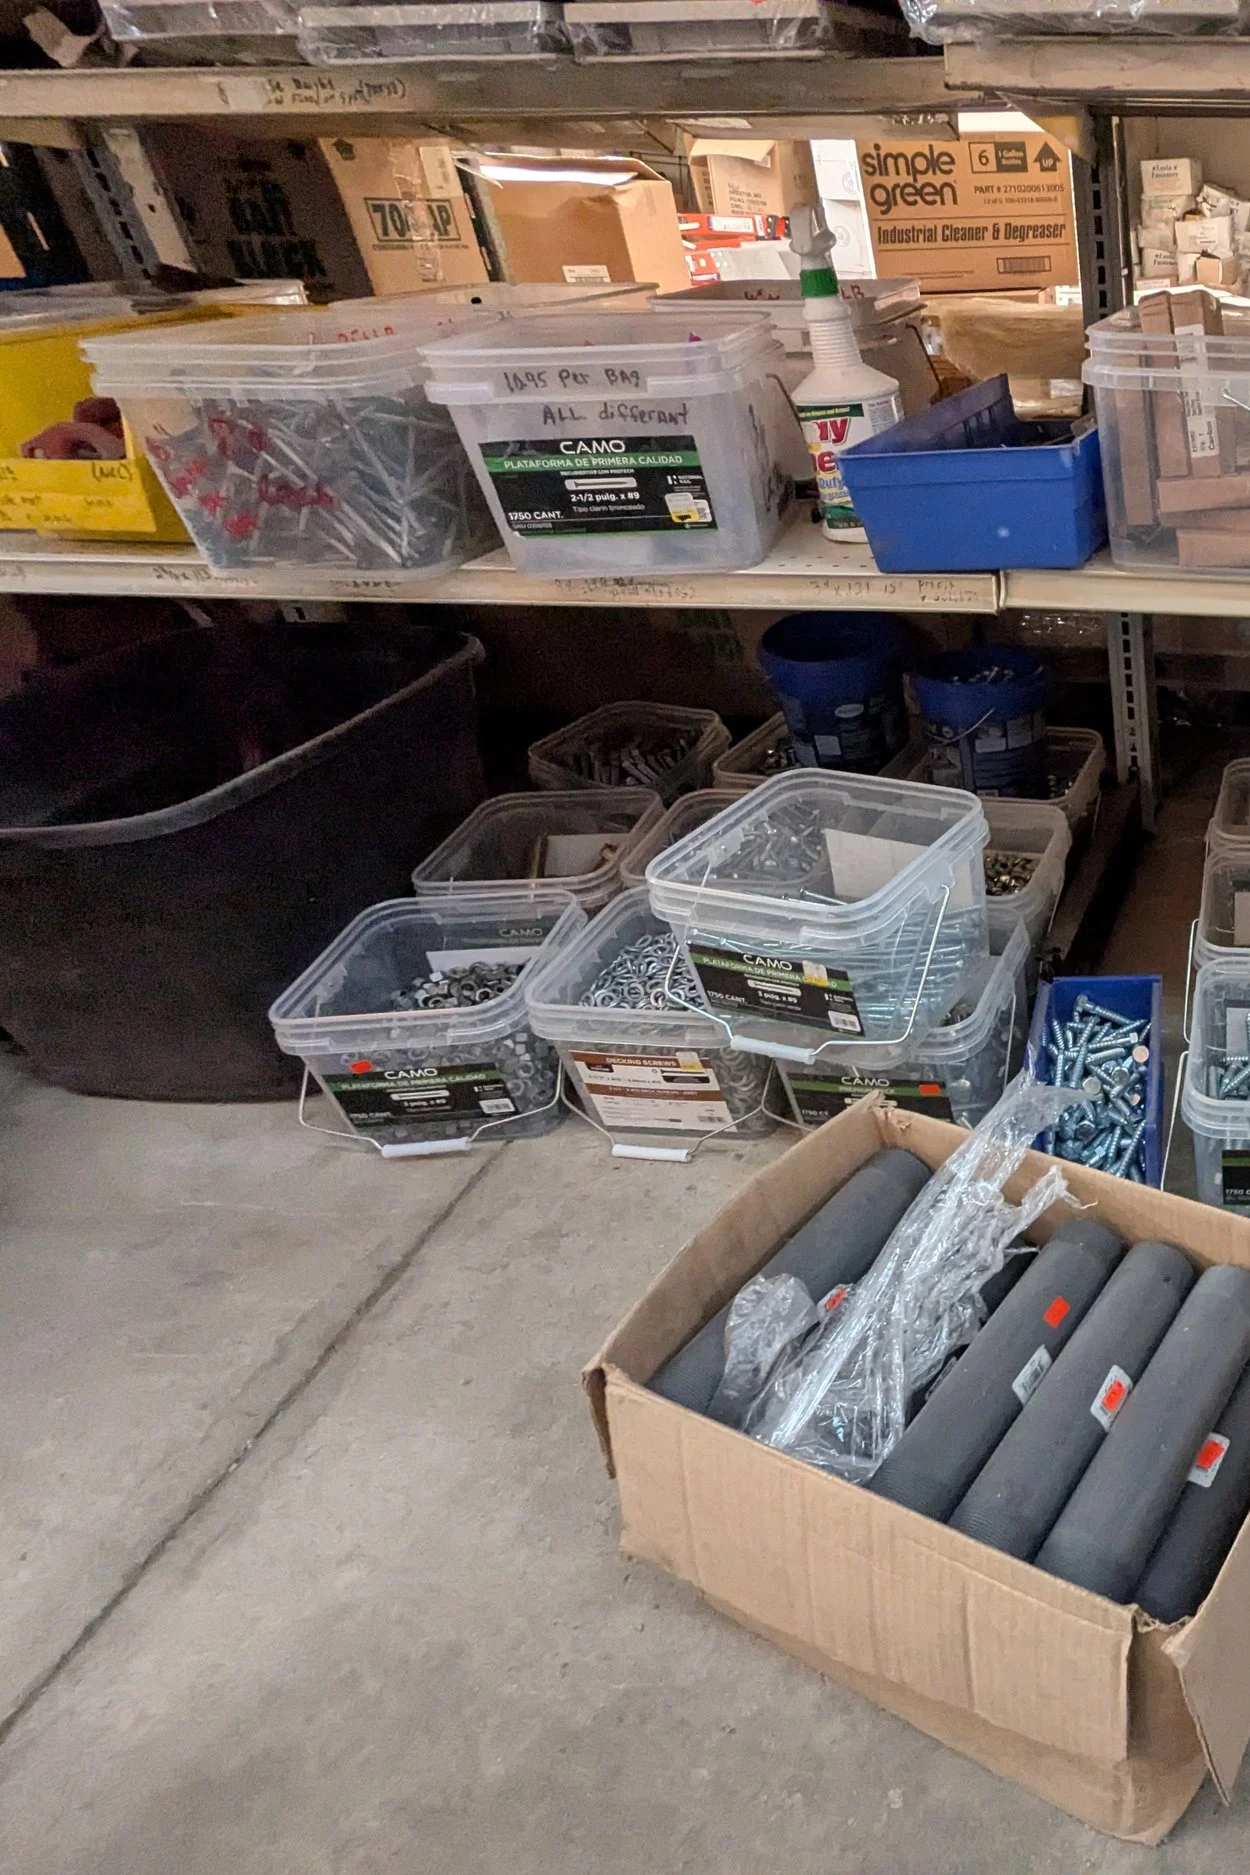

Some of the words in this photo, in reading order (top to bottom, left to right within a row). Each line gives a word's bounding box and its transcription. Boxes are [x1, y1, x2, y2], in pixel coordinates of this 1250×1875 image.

[861, 143, 956, 182] simple
[979, 149, 990, 166] 6
[1042, 158, 1054, 167] UP
[974, 185, 996, 194] PART
[870, 181, 959, 215] green
[877, 225, 938, 245] Industrial
[941, 224, 988, 242] Cleaner
[992, 224, 1001, 241] &
[1004, 222, 1066, 242] Degreaser
[559, 440, 626, 454] CAMO
[503, 459, 572, 469] PLATAFORMA
[575, 458, 590, 467] DE
[591, 456, 637, 467] PRIMERA
[638, 454, 683, 465] CALIDAD
[570, 493, 594, 503] 2-1/2
[596, 492, 618, 503] pulg.
[627, 491, 640, 500] #9
[508, 512, 532, 521] 1750
[534, 510, 565, 520] CANT.
[499, 927, 543, 937] CAMO
[743, 953, 793, 971] CAMO
[755, 968, 765, 976] DE
[606, 1057, 641, 1065] DECKING
[384, 1067, 438, 1080] CAMO
[841, 1076, 890, 1087] CAMO
[1225, 1188, 1244, 1196] 1750
